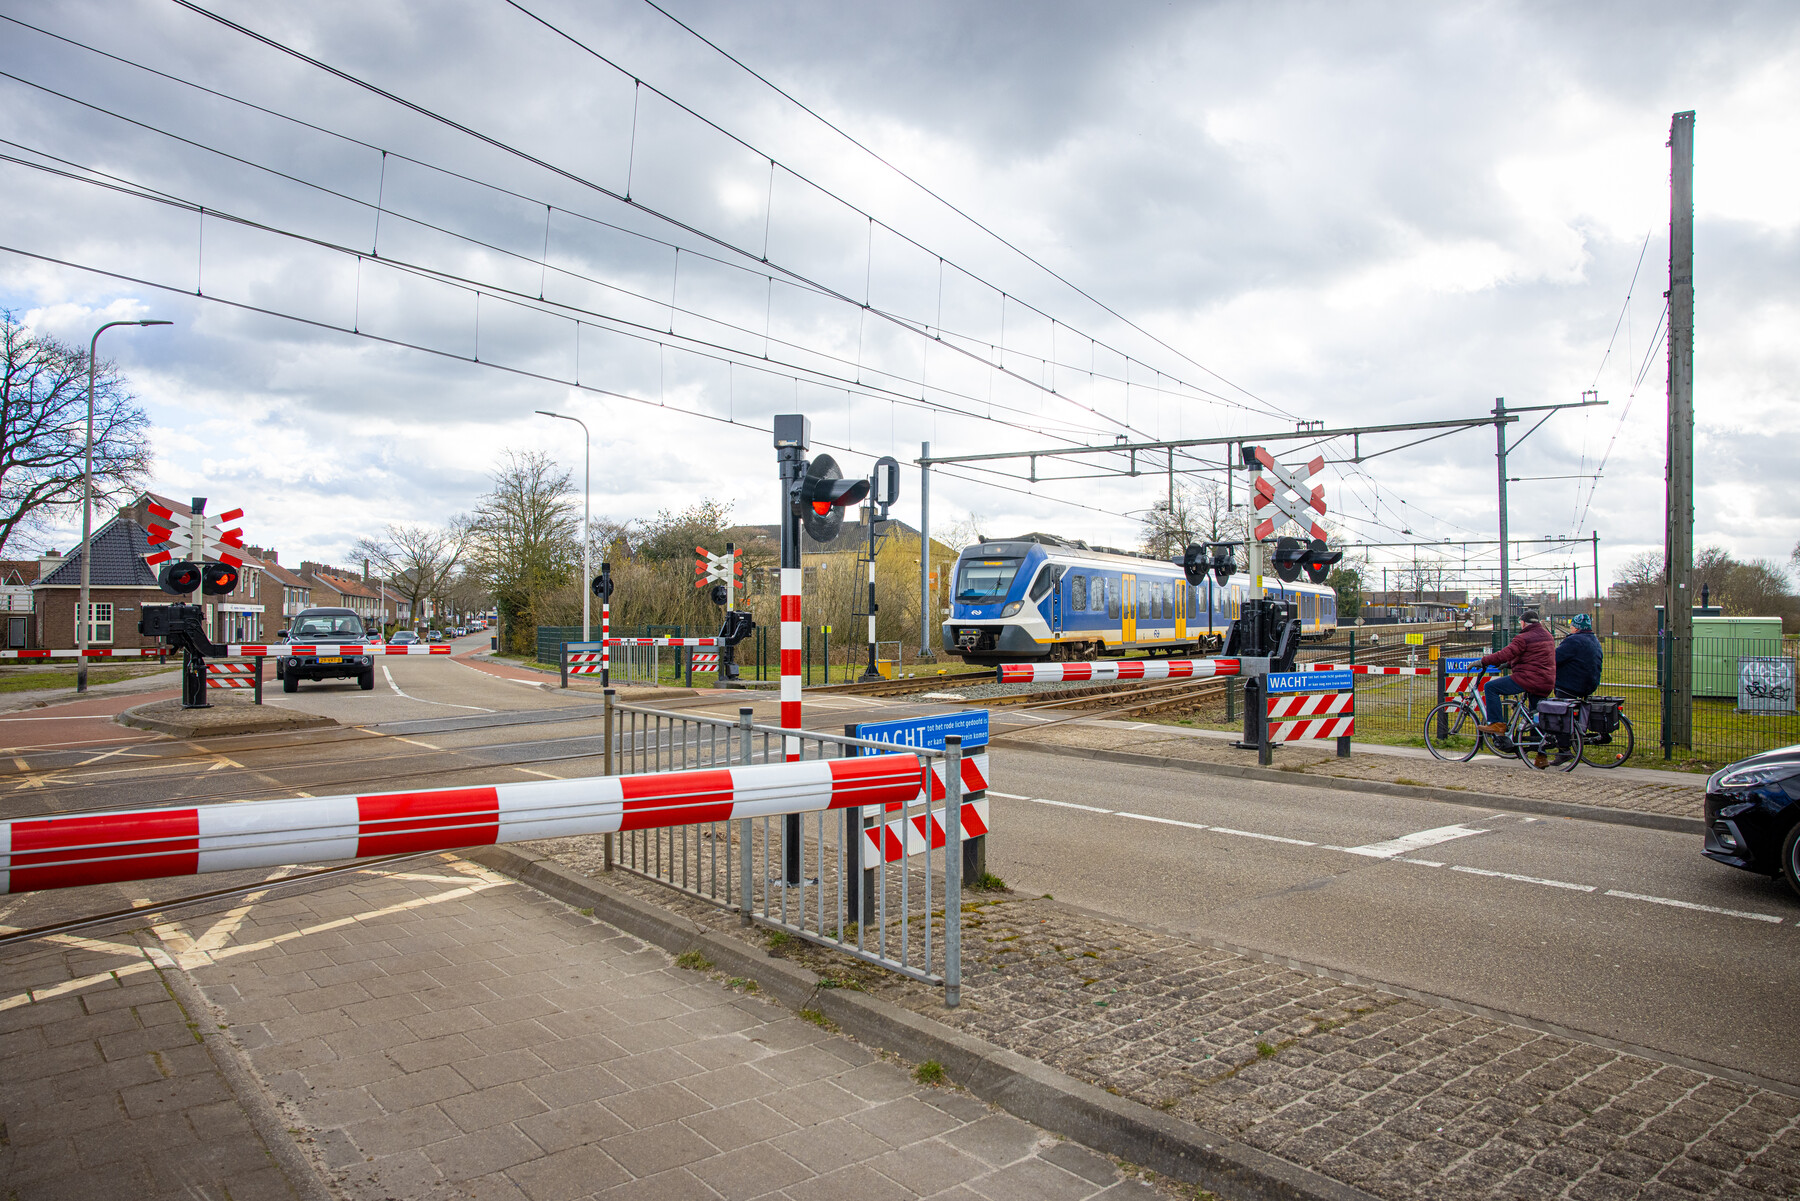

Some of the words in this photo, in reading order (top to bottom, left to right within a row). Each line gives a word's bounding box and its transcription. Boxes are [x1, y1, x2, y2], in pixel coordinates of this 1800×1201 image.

[1269, 676, 1307, 688] WACHT
[944, 721, 954, 730] rode
[955, 720, 965, 728] licht
[966, 718, 983, 728] gedoofd
[862, 727, 926, 756] WACHT
[962, 733, 972, 741] trein
